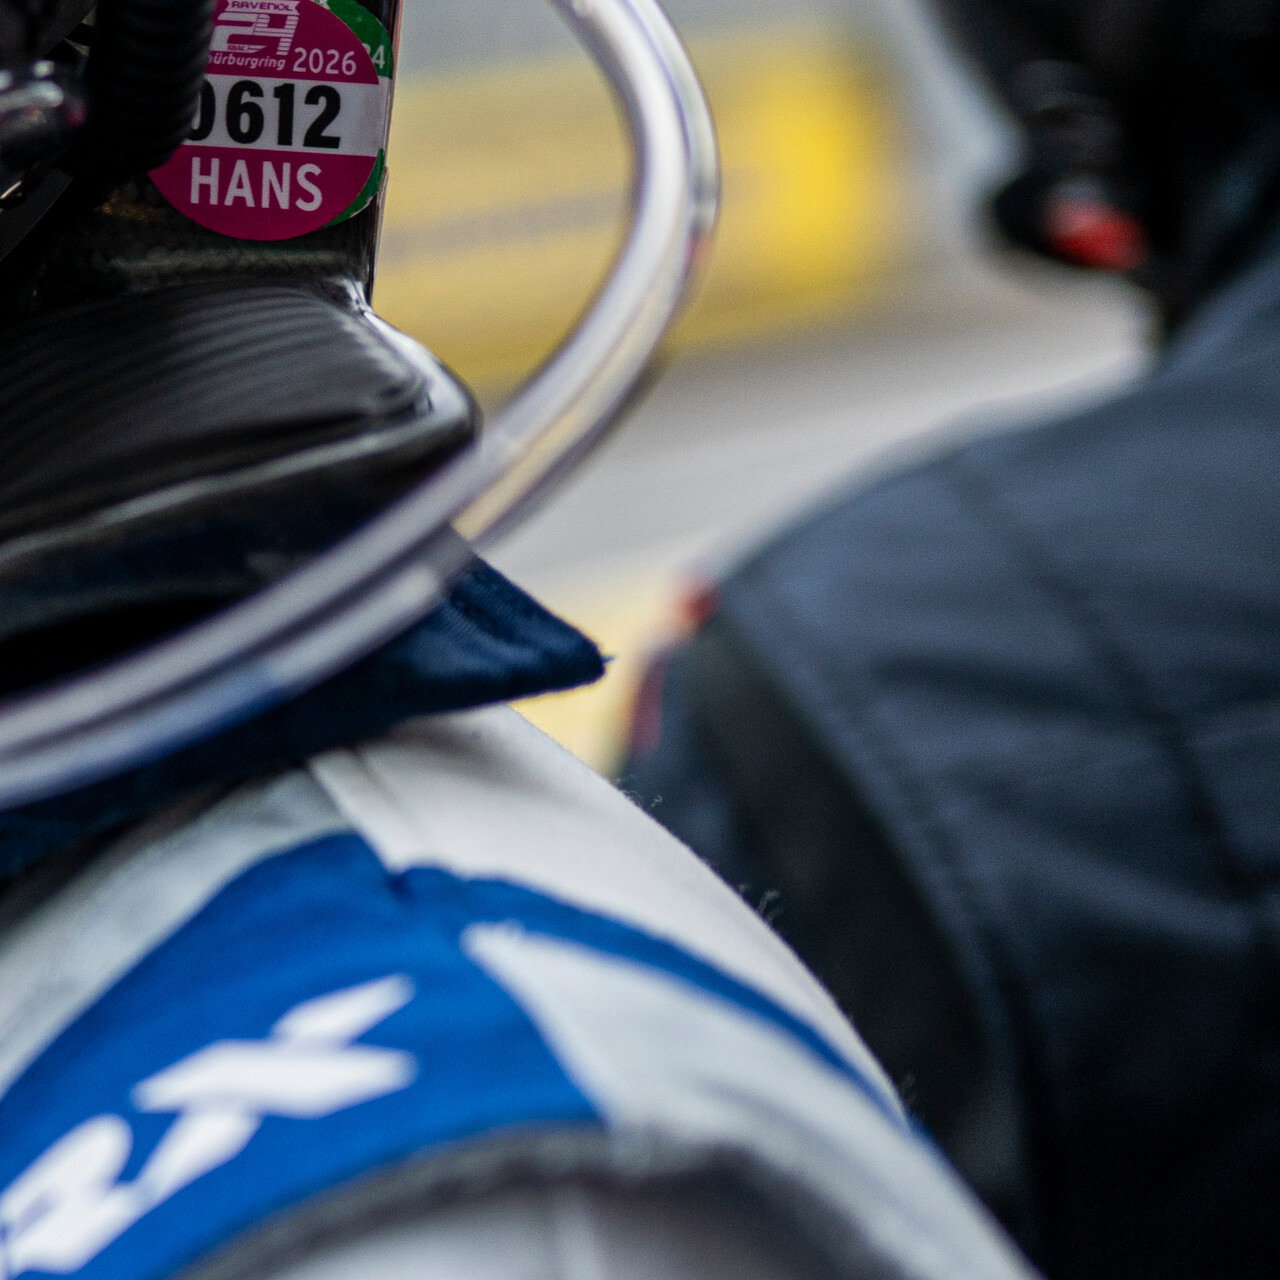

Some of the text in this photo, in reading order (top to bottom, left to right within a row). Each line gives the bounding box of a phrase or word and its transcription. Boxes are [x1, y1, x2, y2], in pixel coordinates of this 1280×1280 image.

[231, 0, 294, 13] RAVENOL
[292, 46, 357, 76] 2026
[189, 156, 323, 212] HANS
